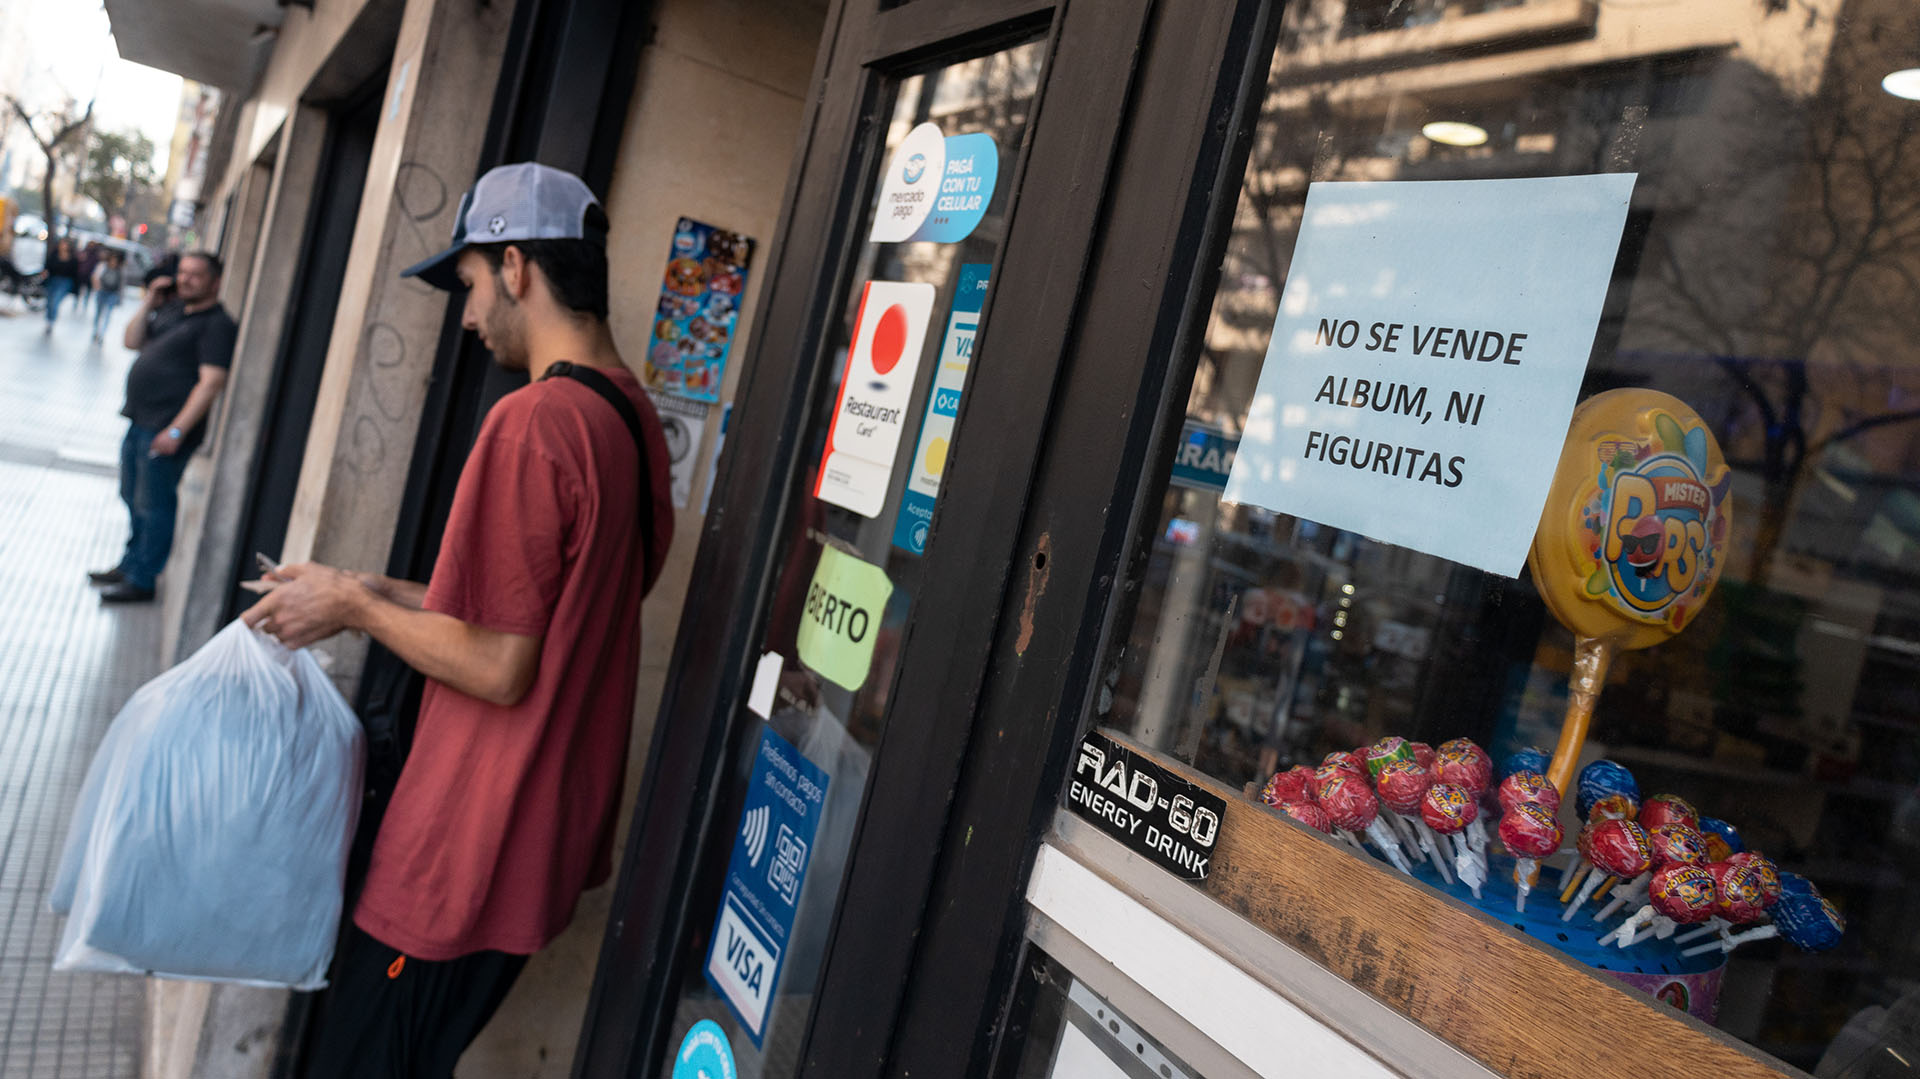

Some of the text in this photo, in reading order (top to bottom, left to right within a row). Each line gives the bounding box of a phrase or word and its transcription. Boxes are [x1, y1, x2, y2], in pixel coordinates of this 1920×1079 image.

[942, 176, 982, 193] CON TU
[947, 155, 975, 174] PAGÁ
[890, 190, 925, 203] mercado
[893, 206, 913, 220] pago
[937, 195, 982, 212] CELULAR
[1315, 318, 1528, 366] NO SE VENDE
[844, 396, 901, 425] Restaurant
[1314, 375, 1486, 426] ALBUM, NI
[1304, 431, 1466, 488] FIGURITAS
[1663, 483, 1707, 508] MISTER
[762, 739, 823, 803] Preferimos pagos
[764, 770, 807, 816] sin contacto
[1076, 742, 1219, 847] RAD-60
[1069, 780, 1209, 879] ENERGY DRINK
[727, 921, 764, 999] VISA
